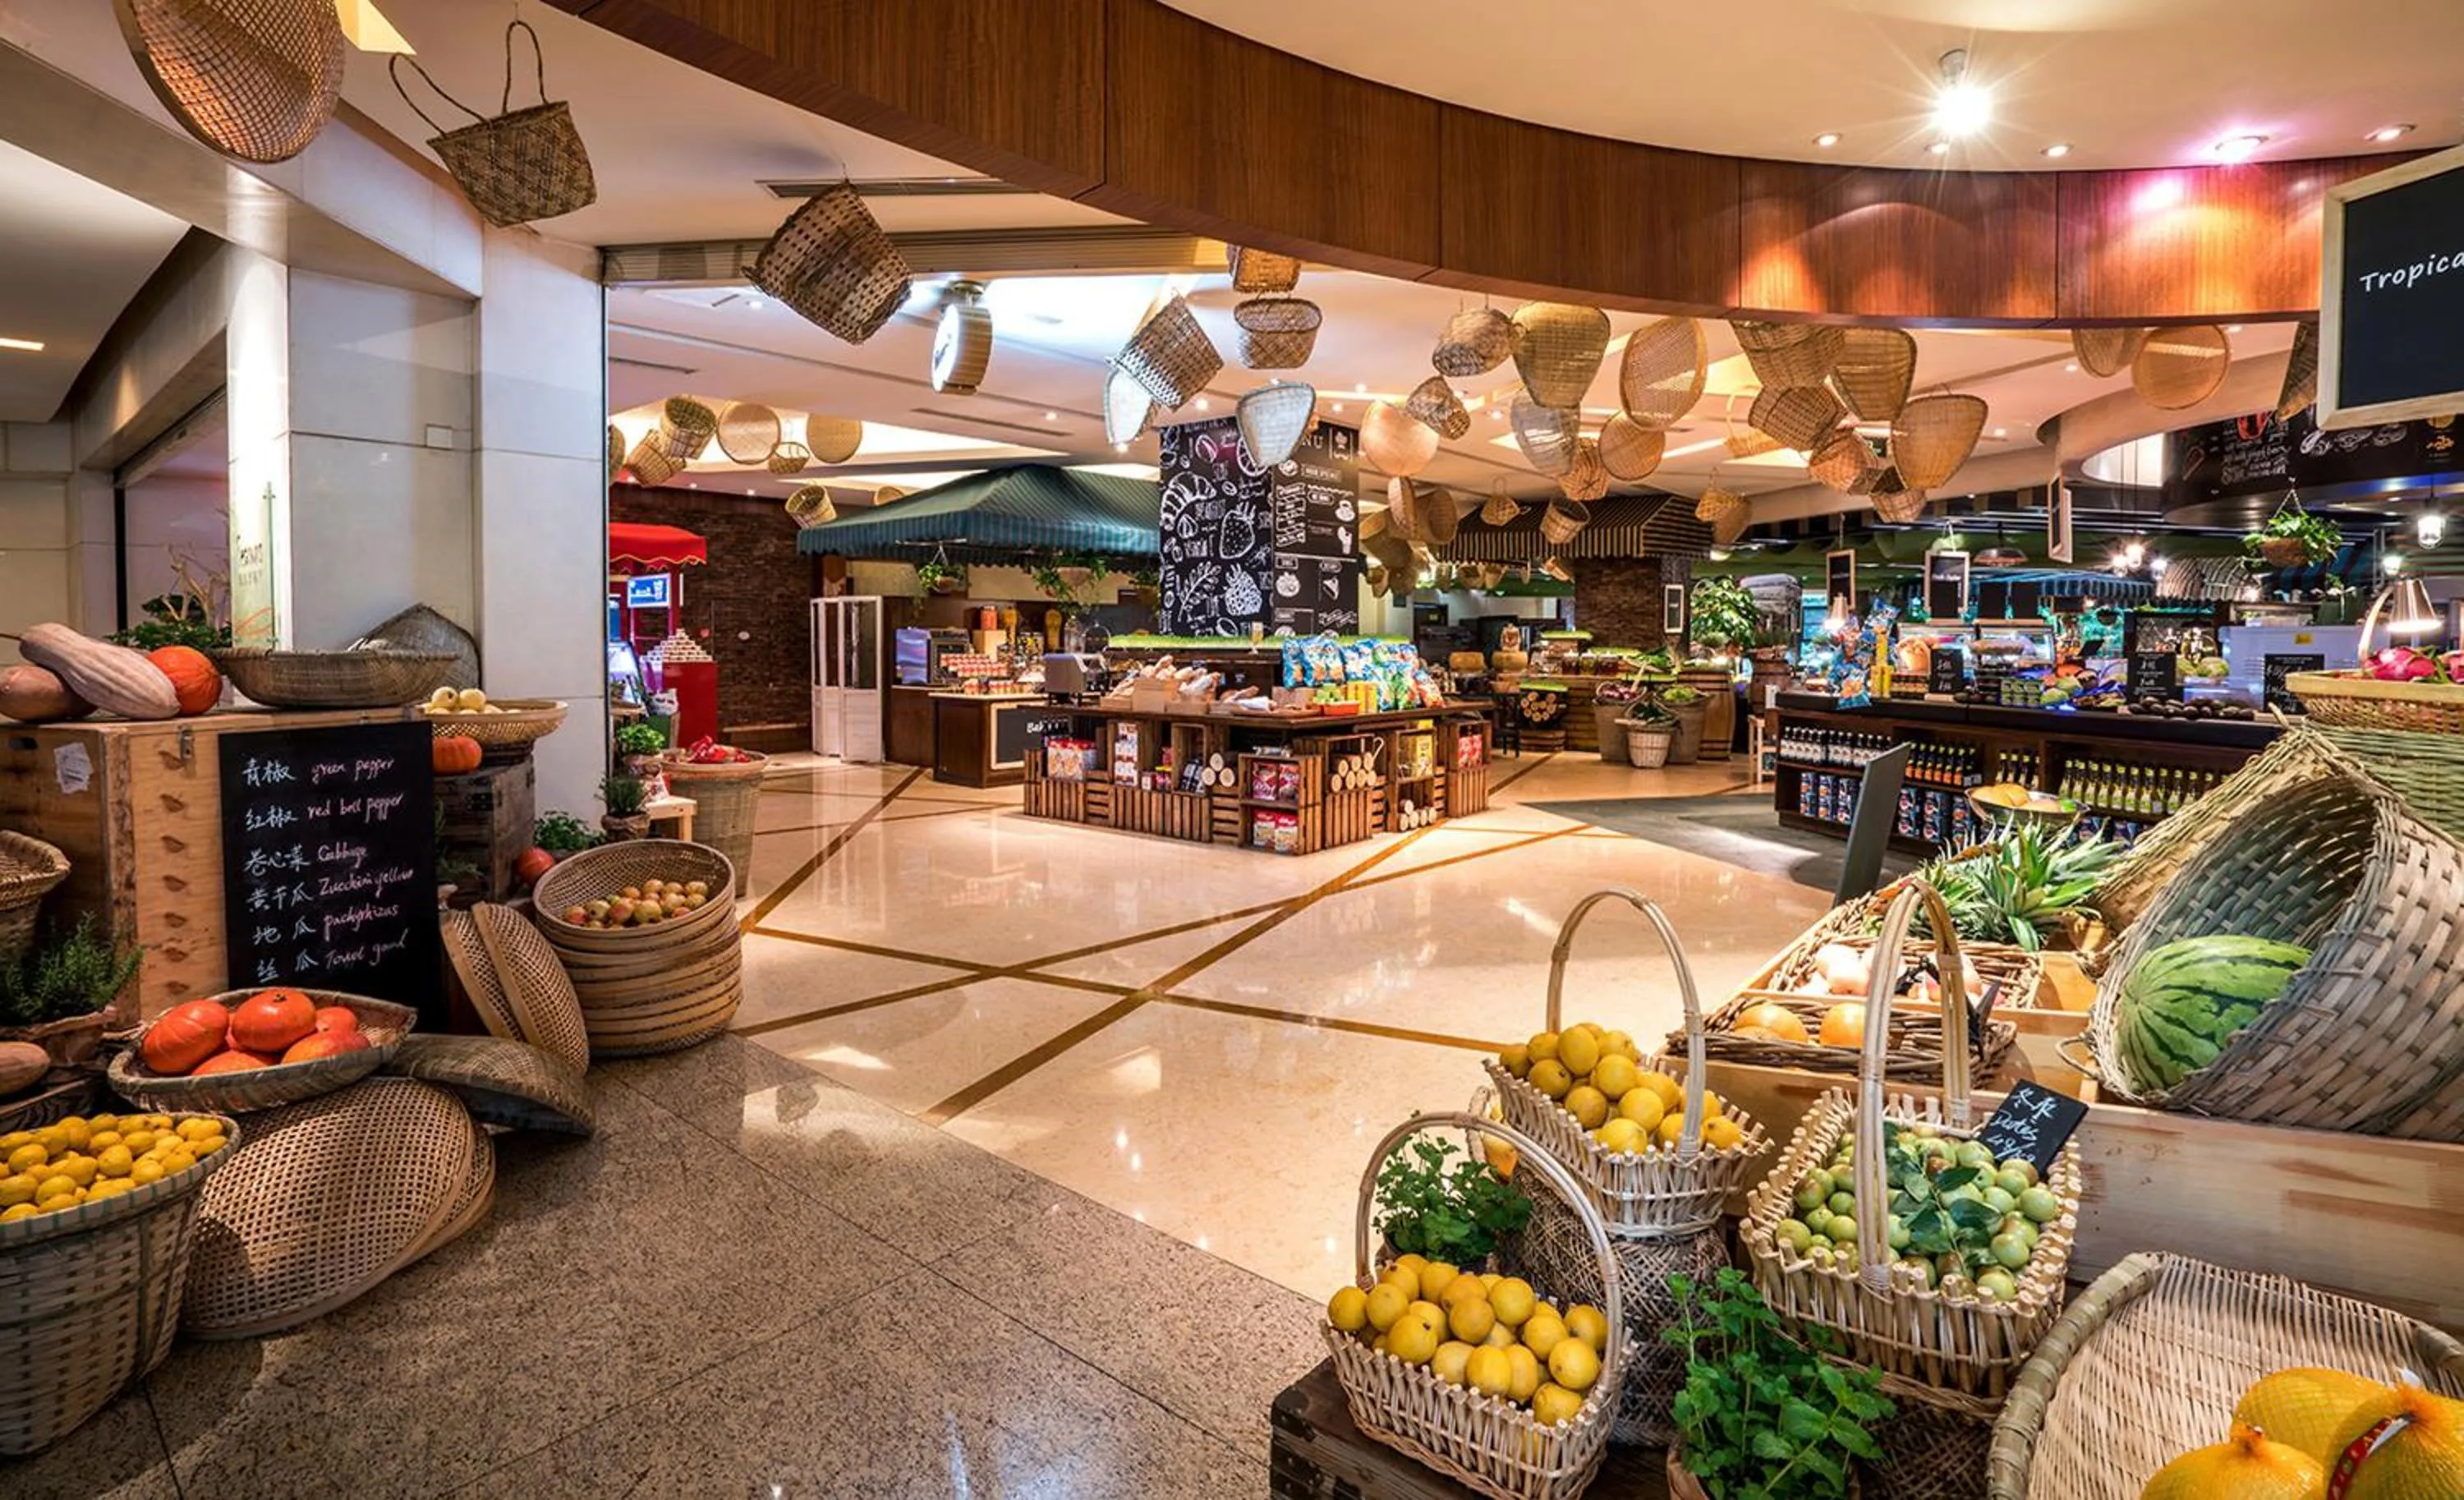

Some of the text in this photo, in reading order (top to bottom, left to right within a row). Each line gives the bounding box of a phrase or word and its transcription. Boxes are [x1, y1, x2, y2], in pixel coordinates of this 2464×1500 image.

[2359, 251, 2464, 292] Tropica
[242, 757, 296, 787] 青椒
[312, 757, 394, 785] green pepper
[246, 804, 298, 831] 红椒
[307, 793, 404, 824] red bell pepper
[245, 843, 310, 877] 卷心菜
[1990, 1109, 2039, 1141] Dates
